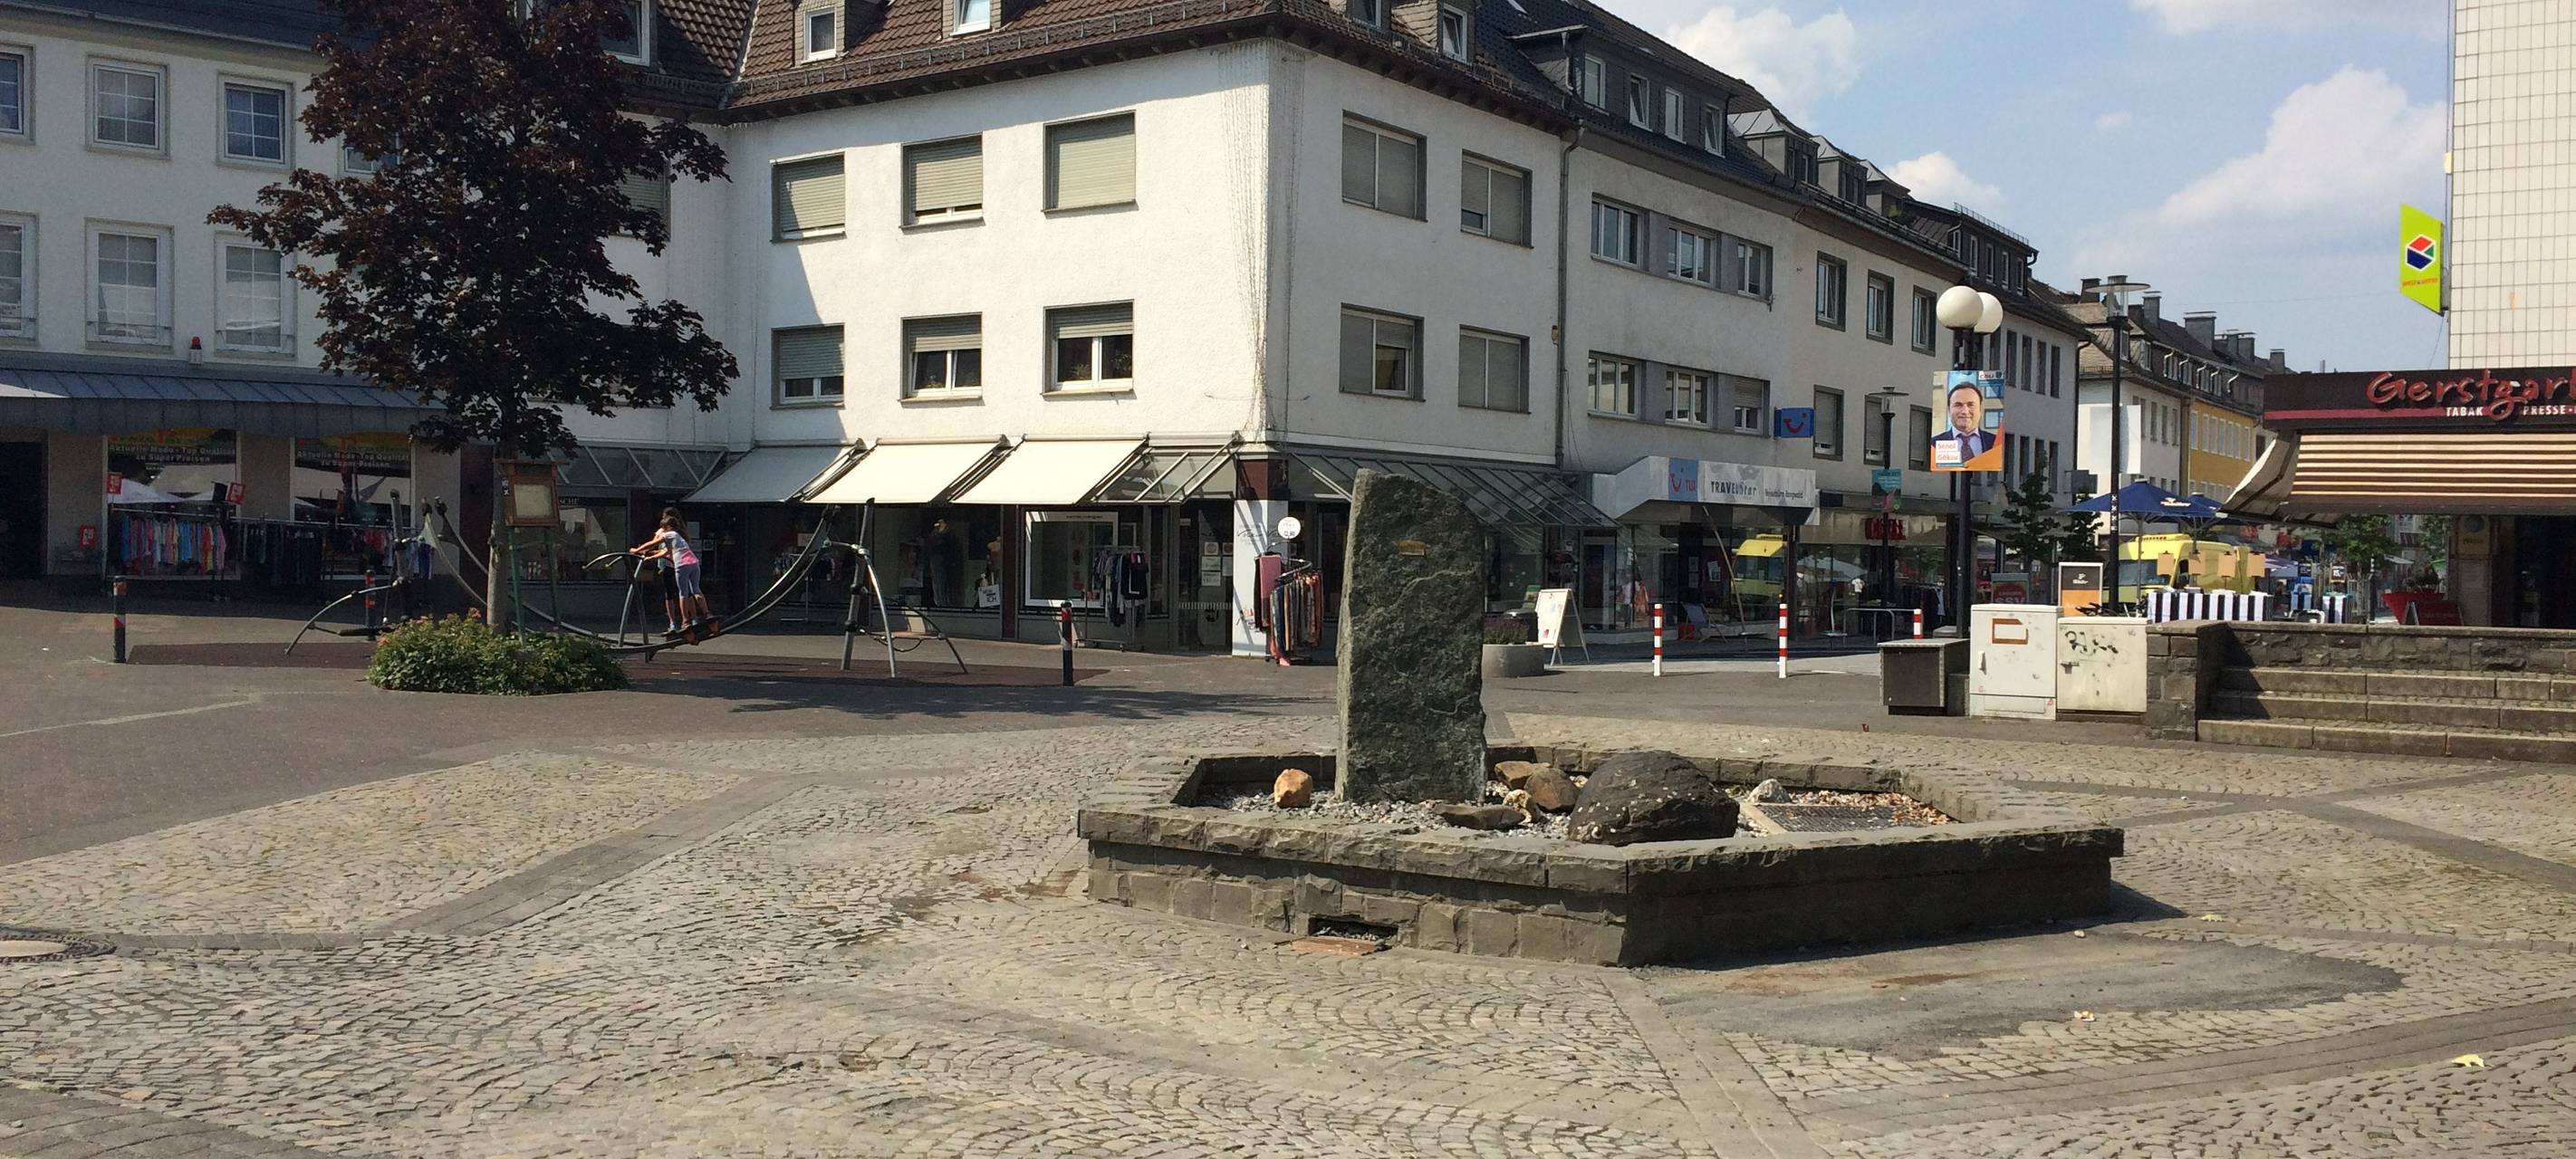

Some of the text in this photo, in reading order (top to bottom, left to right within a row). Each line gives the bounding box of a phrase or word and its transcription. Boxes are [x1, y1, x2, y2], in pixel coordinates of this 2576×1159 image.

[2446, 404, 2566, 417] TABAK PRESSE
[181, 448, 198, 456] Top
[1685, 479, 1697, 492] TUI
